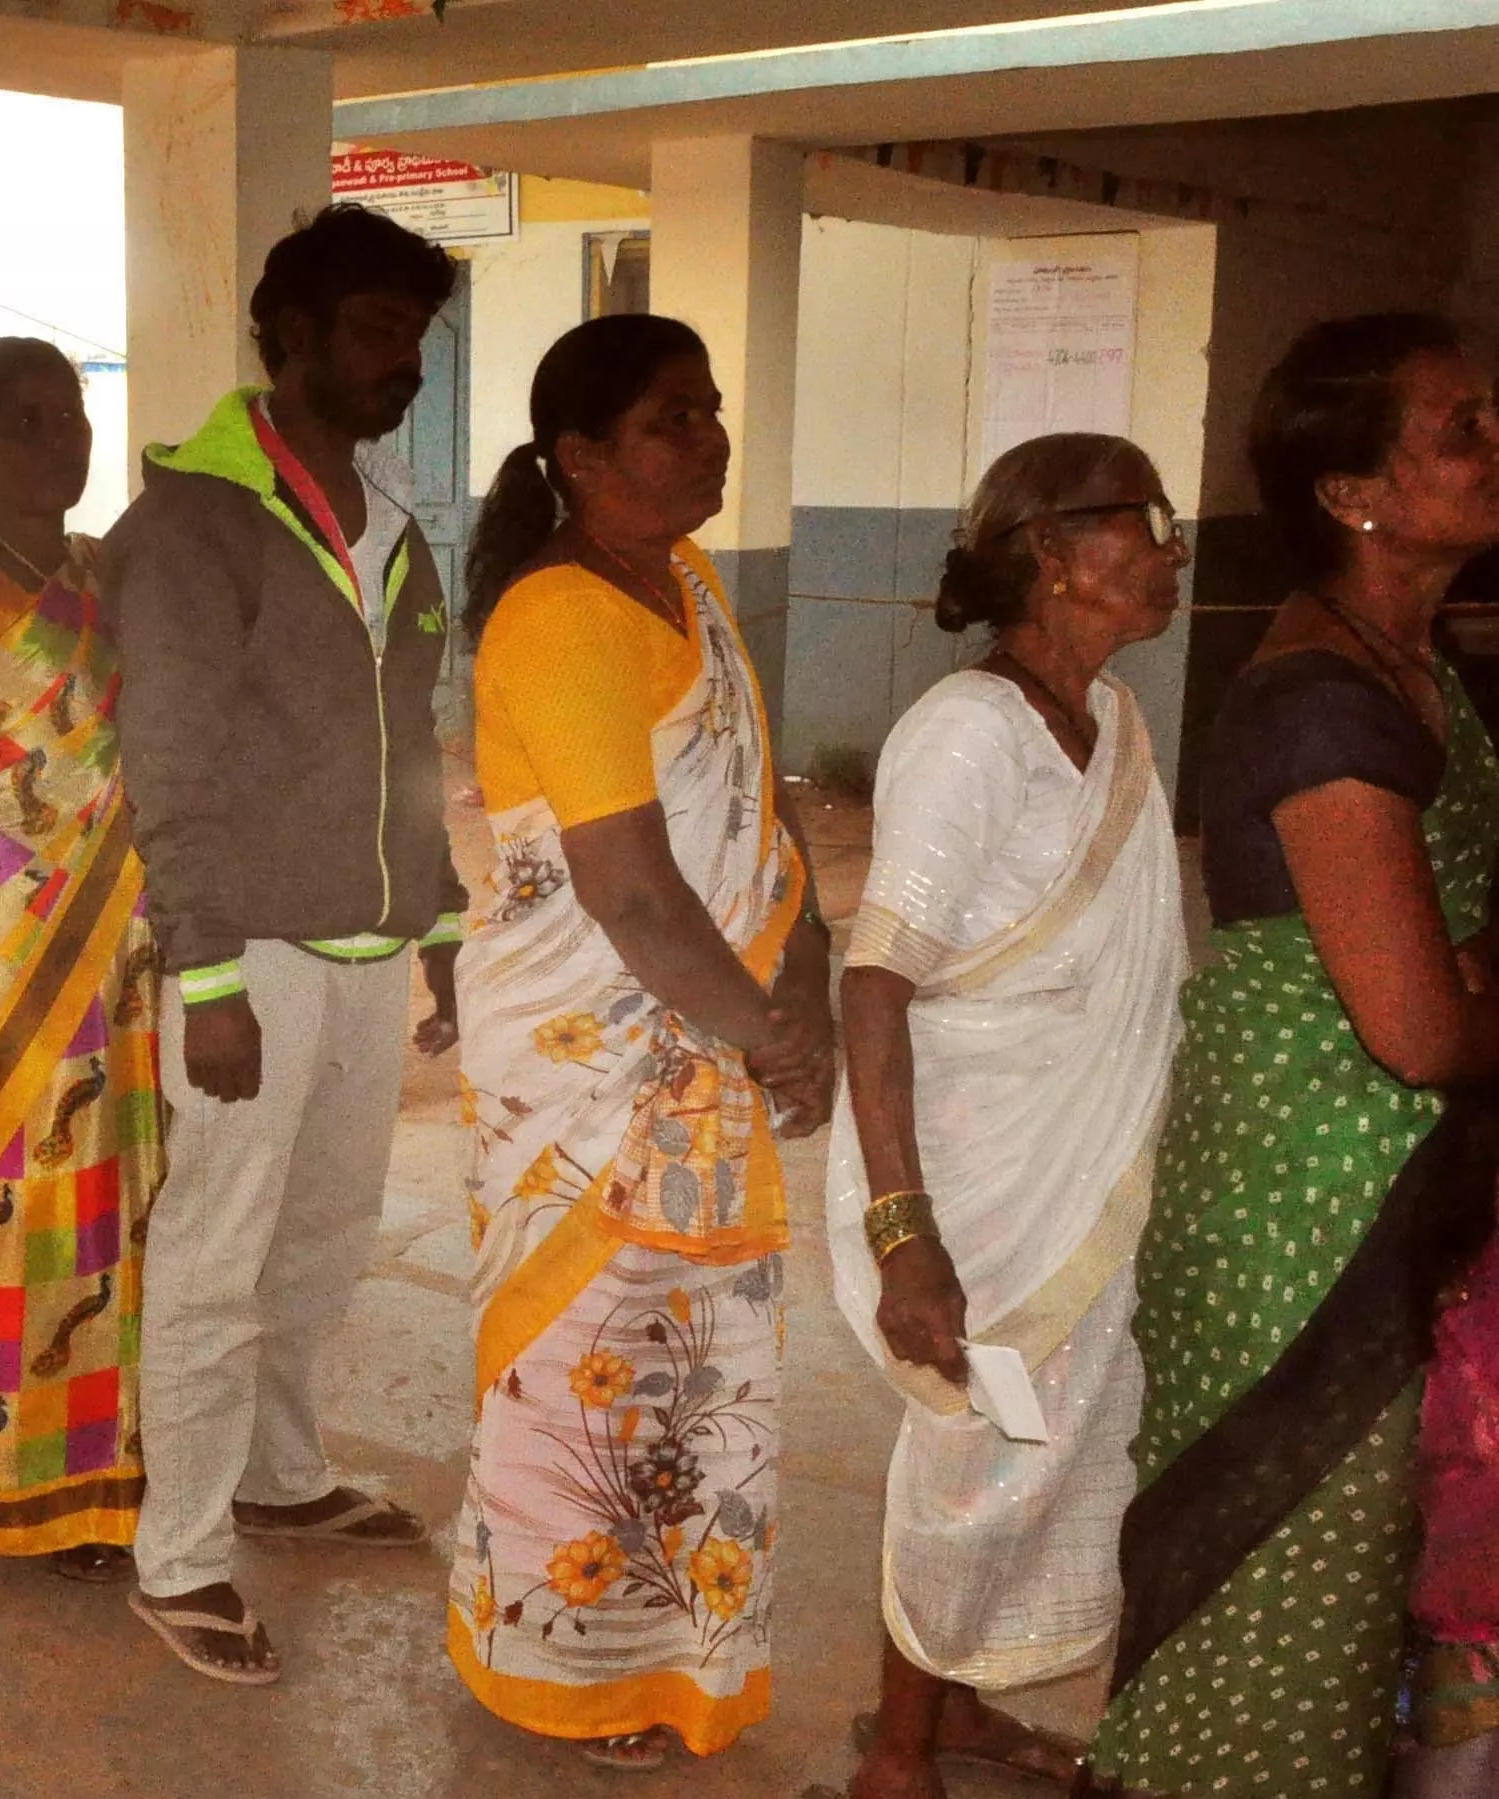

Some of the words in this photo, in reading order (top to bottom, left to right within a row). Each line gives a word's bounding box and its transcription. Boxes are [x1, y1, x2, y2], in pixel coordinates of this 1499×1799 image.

[369, 175, 377, 184] &
[379, 171, 433, 183] Pre-primary
[435, 166, 469, 178] School
